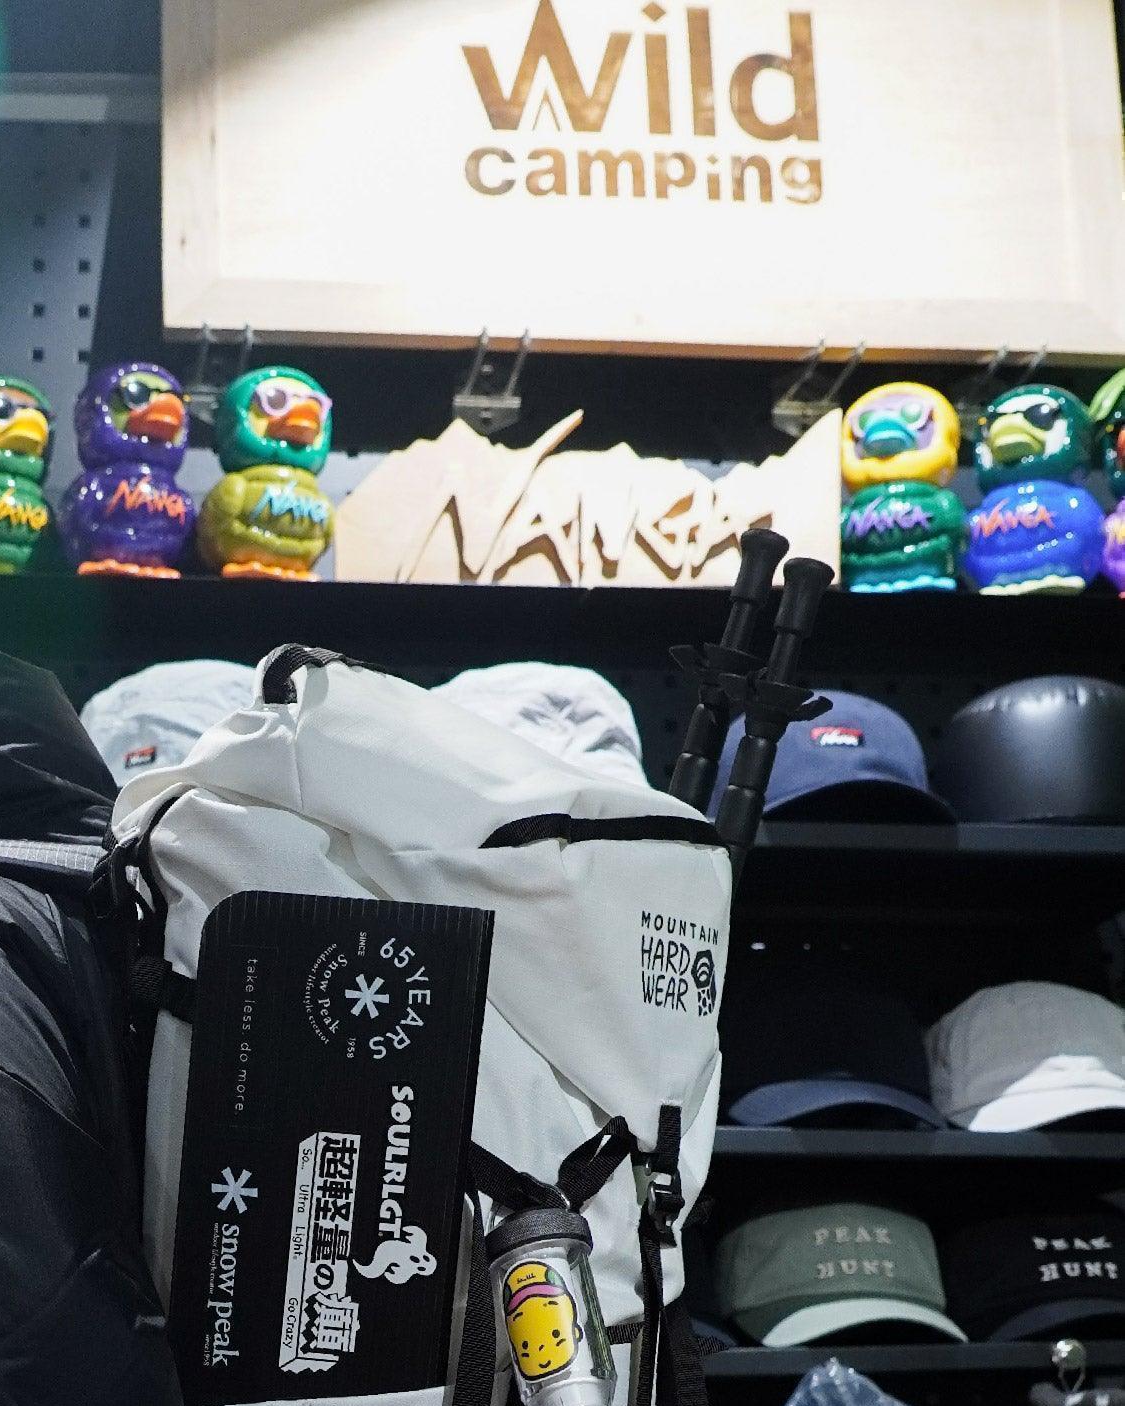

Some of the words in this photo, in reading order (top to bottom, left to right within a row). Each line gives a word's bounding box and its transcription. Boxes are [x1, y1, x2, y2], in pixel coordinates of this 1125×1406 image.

[461, 0, 819, 141] Wild
[464, 146, 823, 204] camping
[357, 931, 367, 957] SINCE
[641, 910, 719, 945] MOUNTAIN
[641, 935, 691, 976] HARD
[245, 959, 258, 993] take
[641, 970, 689, 1012] WEAR
[240, 1042, 252, 1062] do
[346, 1037, 357, 1058] 1958
[297, 1184, 310, 1213] Ultra
[218, 1223, 240, 1296] snow
[207, 1299, 240, 1366] peak
[283, 1315, 297, 1350] Crazy
